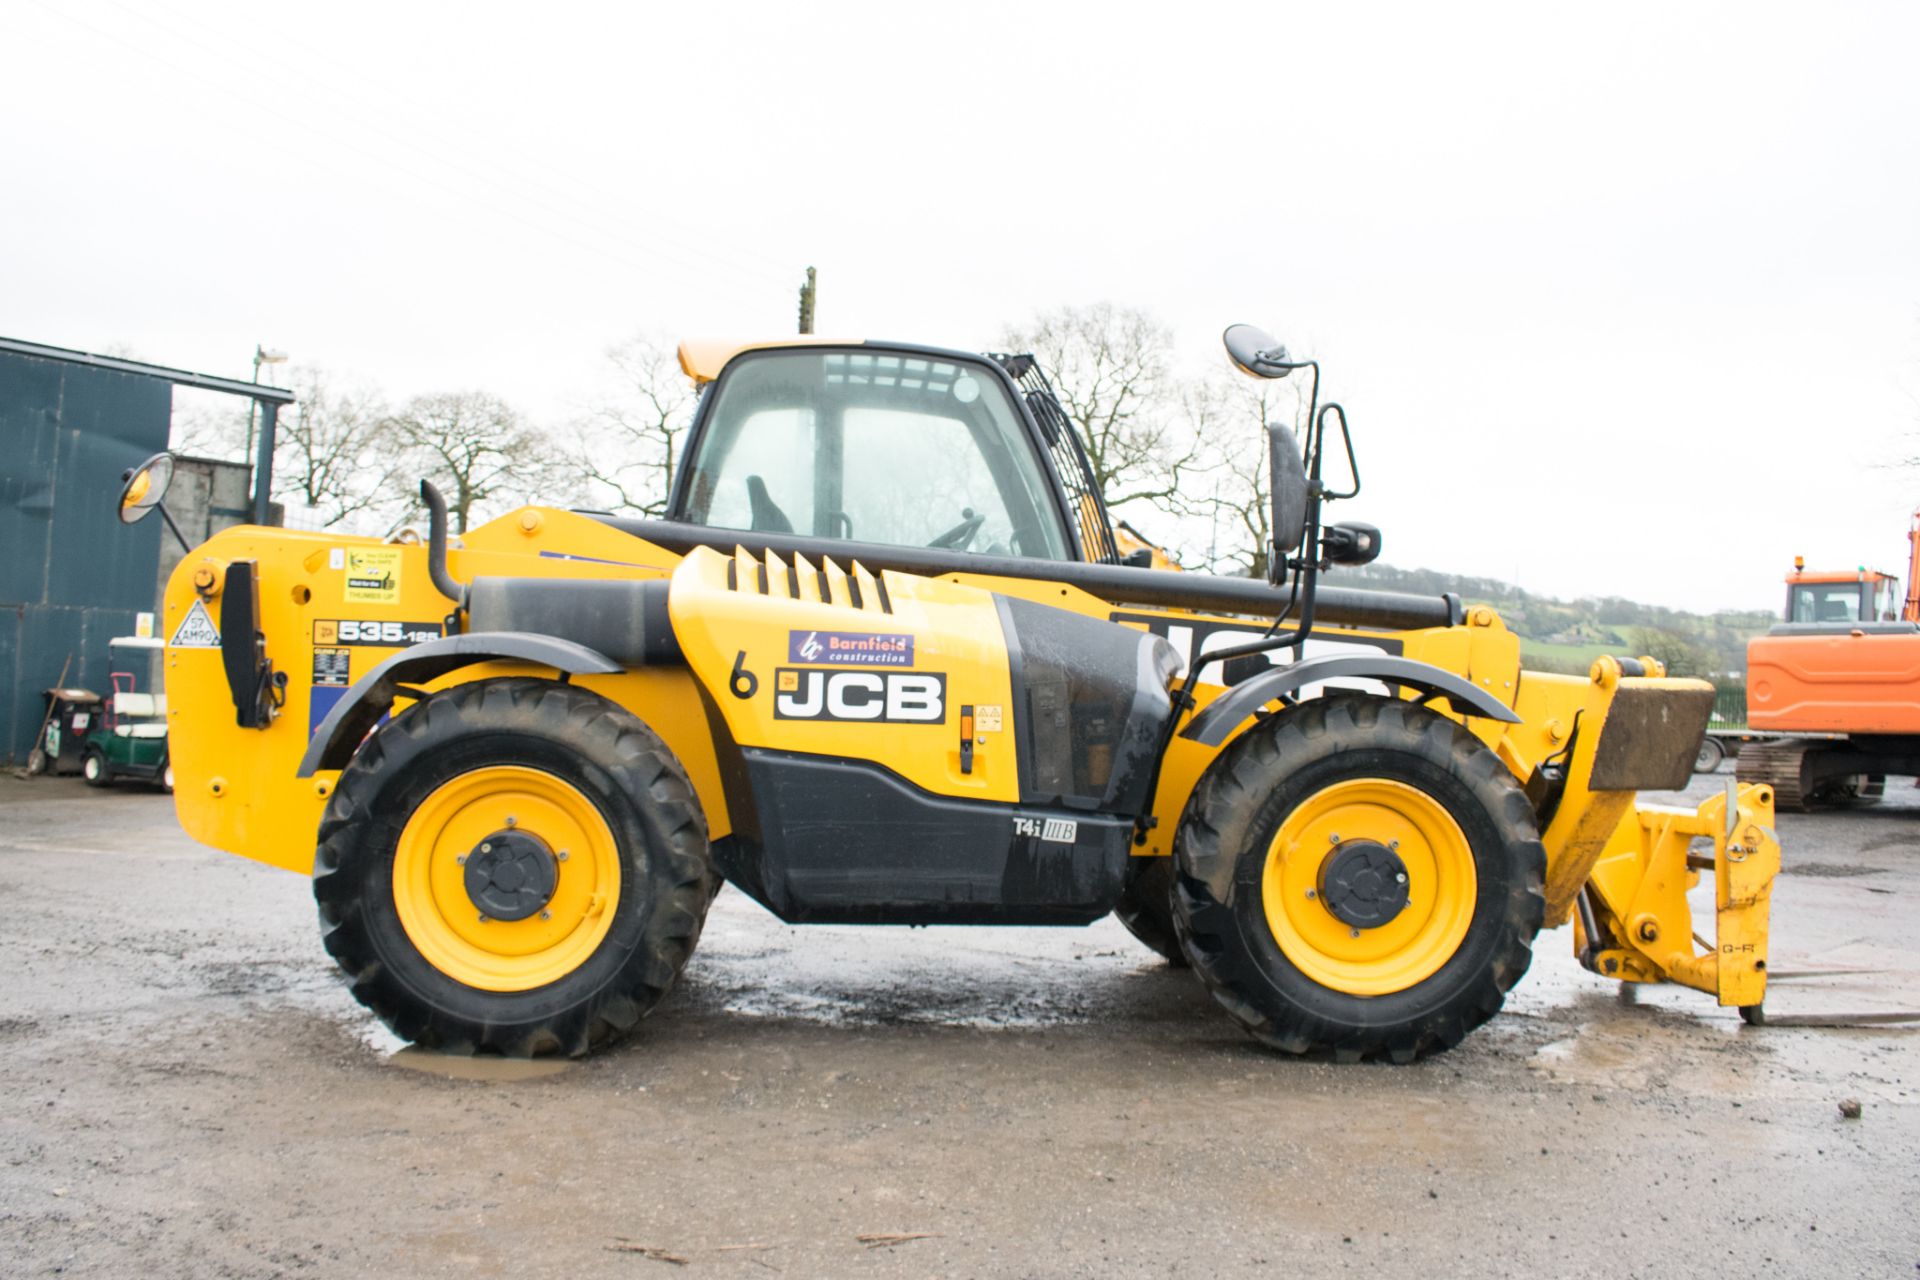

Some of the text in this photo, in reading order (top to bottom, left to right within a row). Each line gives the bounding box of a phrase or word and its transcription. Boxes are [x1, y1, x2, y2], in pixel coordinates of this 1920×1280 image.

[191, 617, 204, 629] 57
[829, 636, 906, 651] Barnfield
[829, 652, 906, 663] construction
[729, 650, 758, 700] 6
[777, 672, 943, 720] JCB
[1013, 817, 1041, 837] T4i
